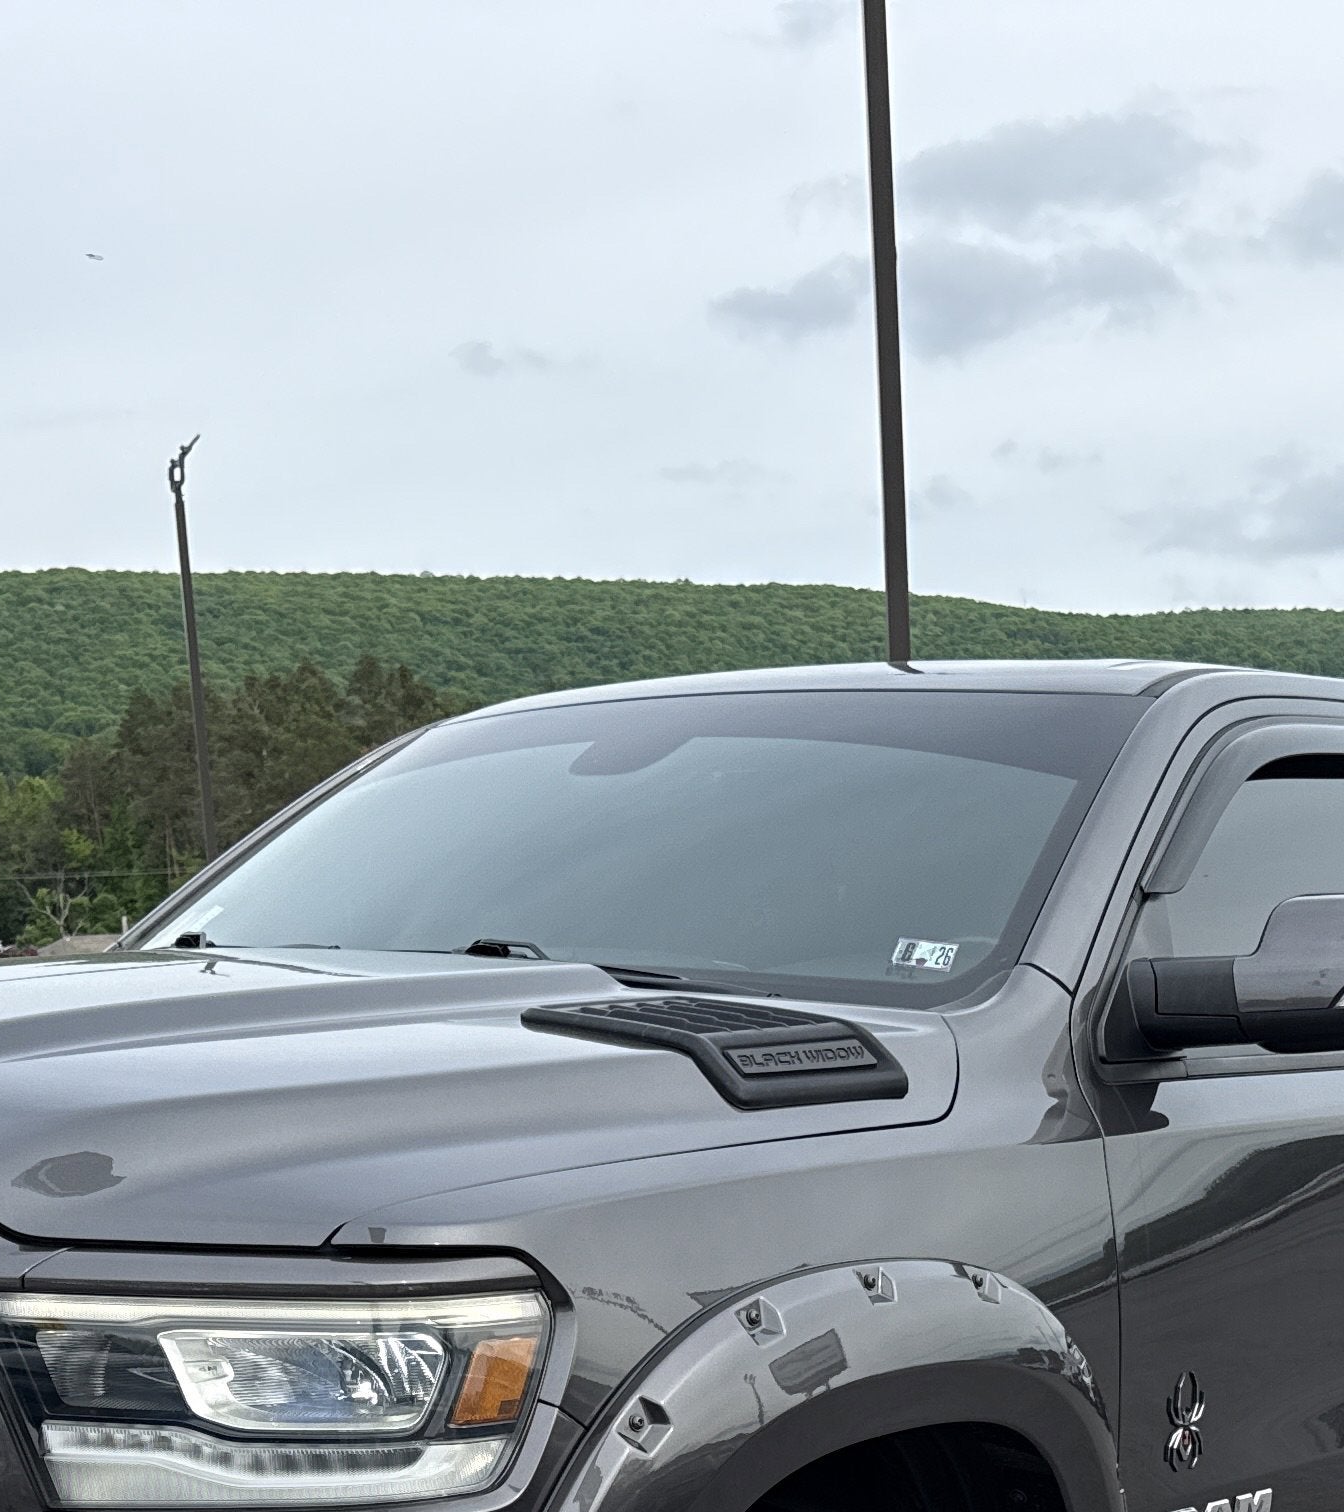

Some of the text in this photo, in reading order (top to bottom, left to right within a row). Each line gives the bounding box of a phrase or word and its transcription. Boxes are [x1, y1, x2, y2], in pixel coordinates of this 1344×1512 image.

[934, 946, 954, 966] 26
[737, 1045, 865, 1068] BLACK WIDOW
